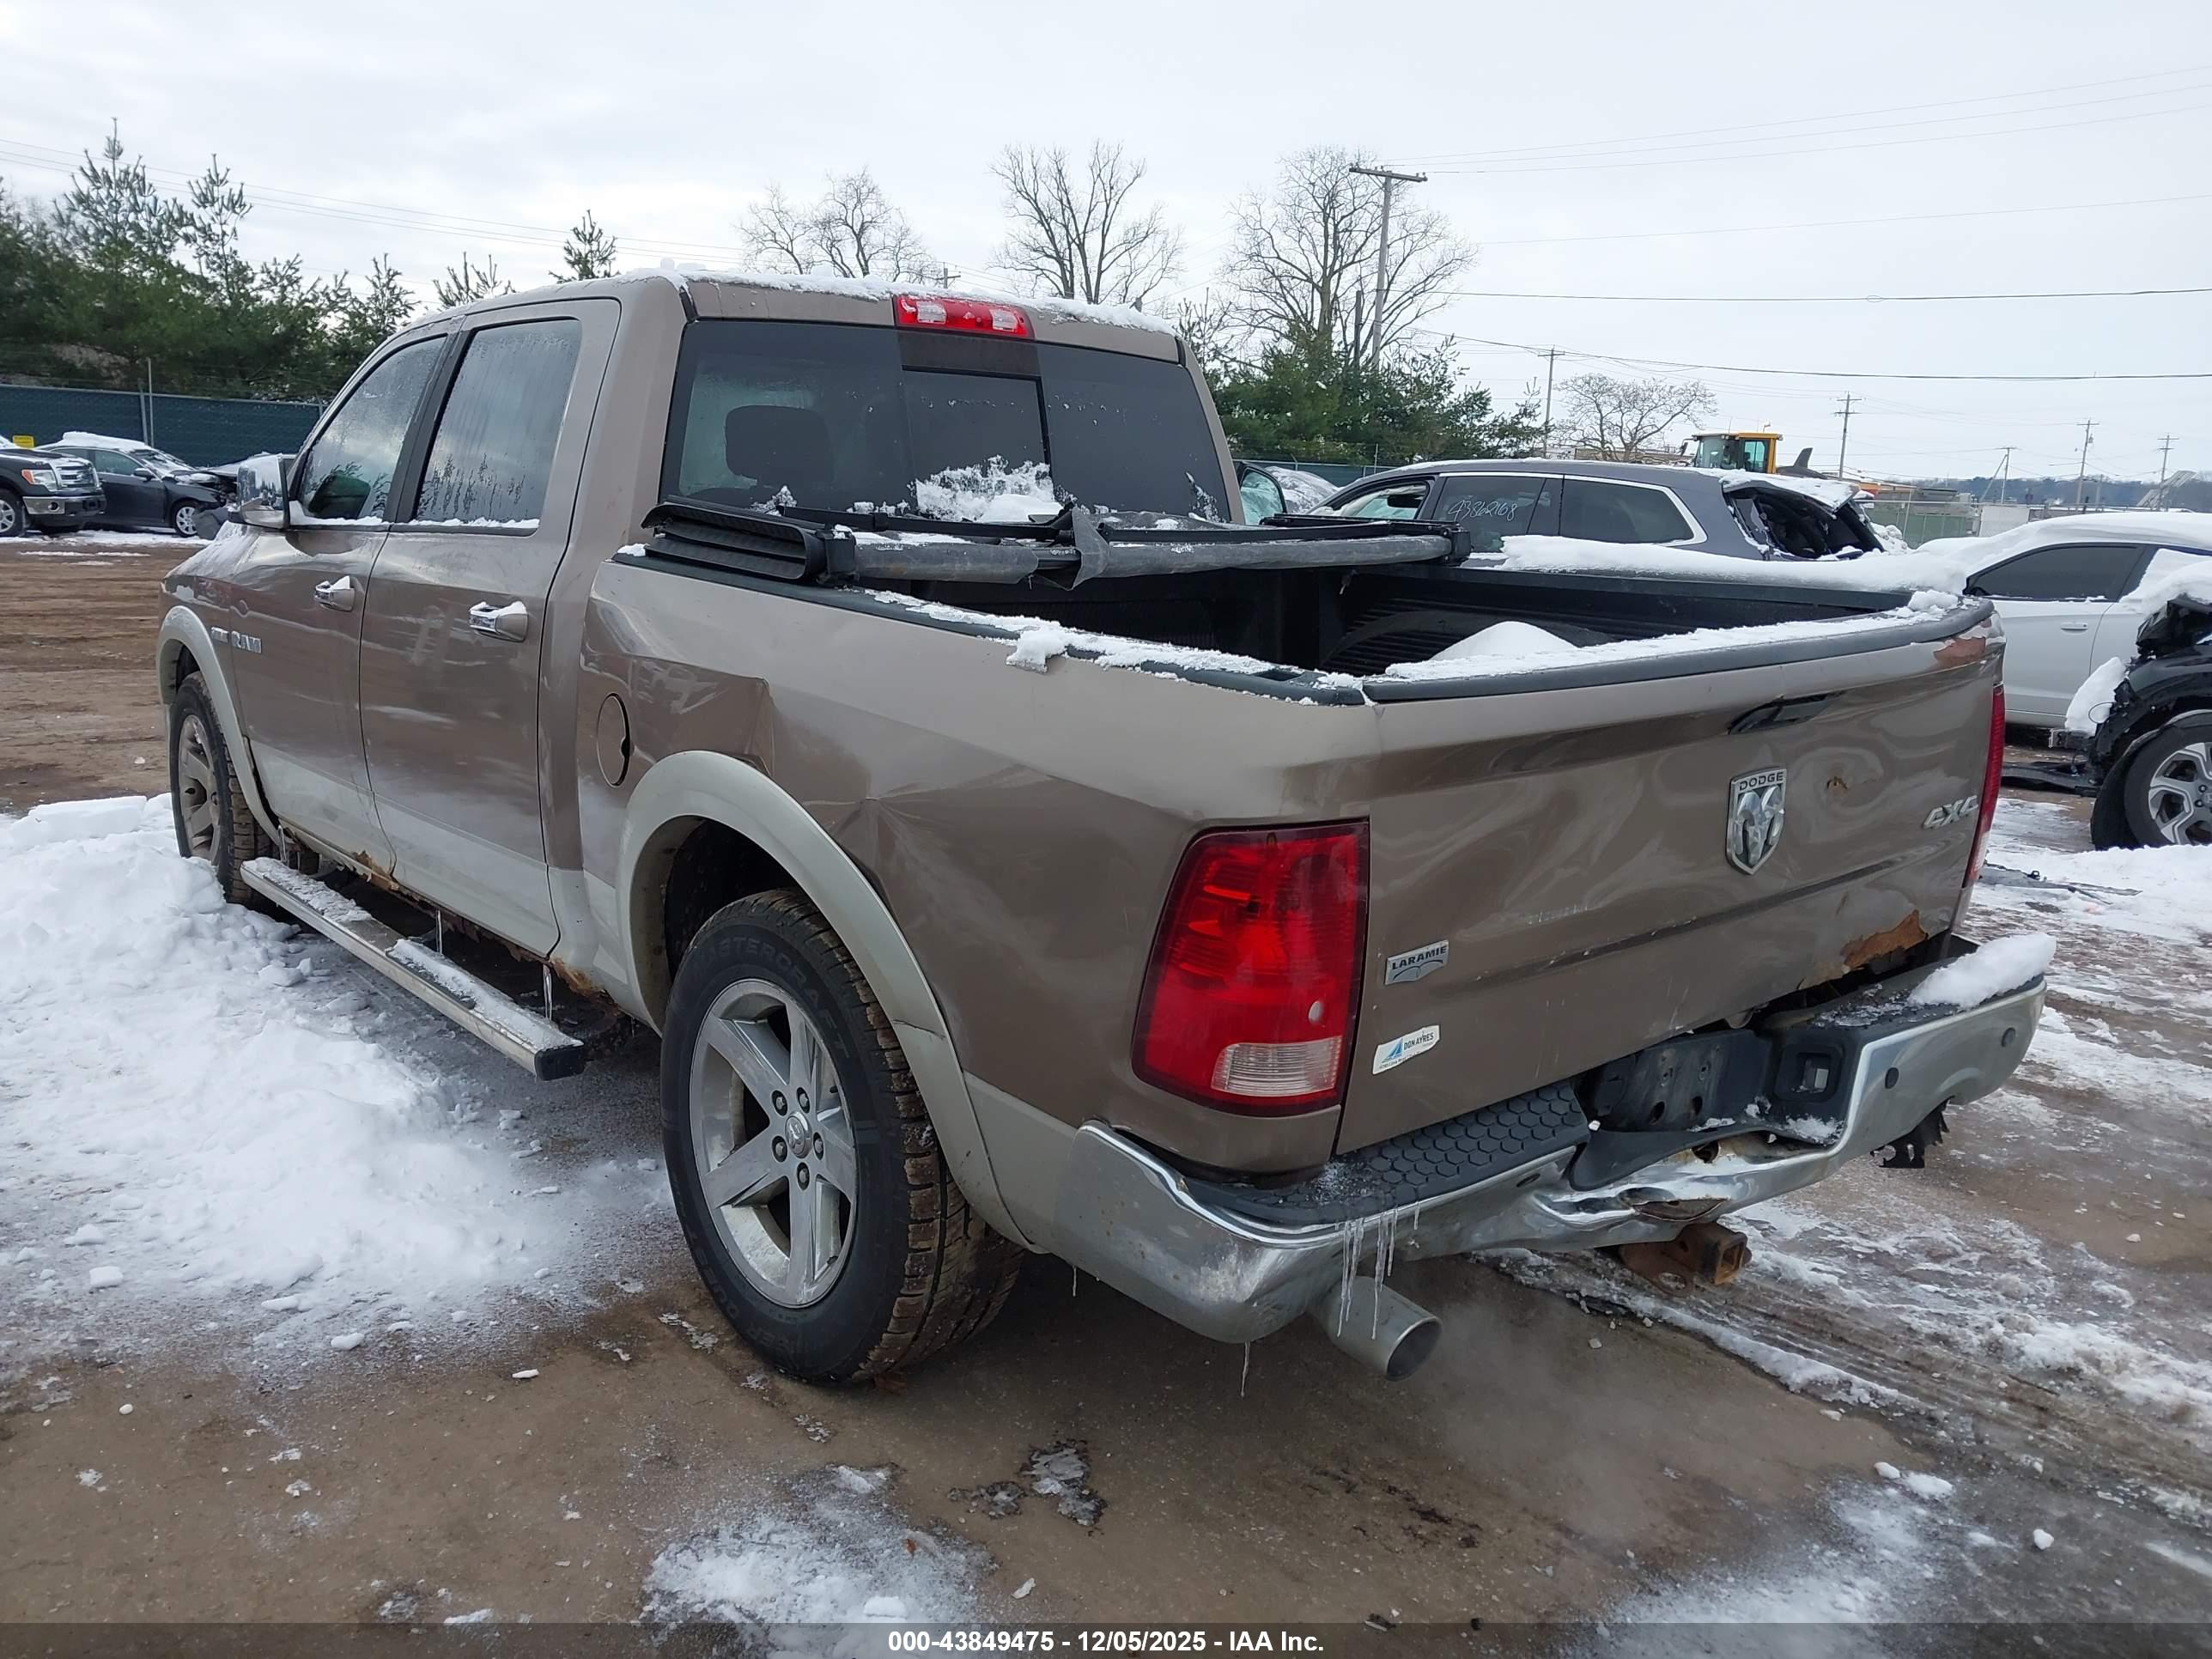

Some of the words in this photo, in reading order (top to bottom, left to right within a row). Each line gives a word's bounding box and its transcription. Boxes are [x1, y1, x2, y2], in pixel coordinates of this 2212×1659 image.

[1740, 772, 1784, 791] DODGE
[1392, 946, 1447, 970] LARAMIE
[697, 935, 851, 1058] STERCRAFT
